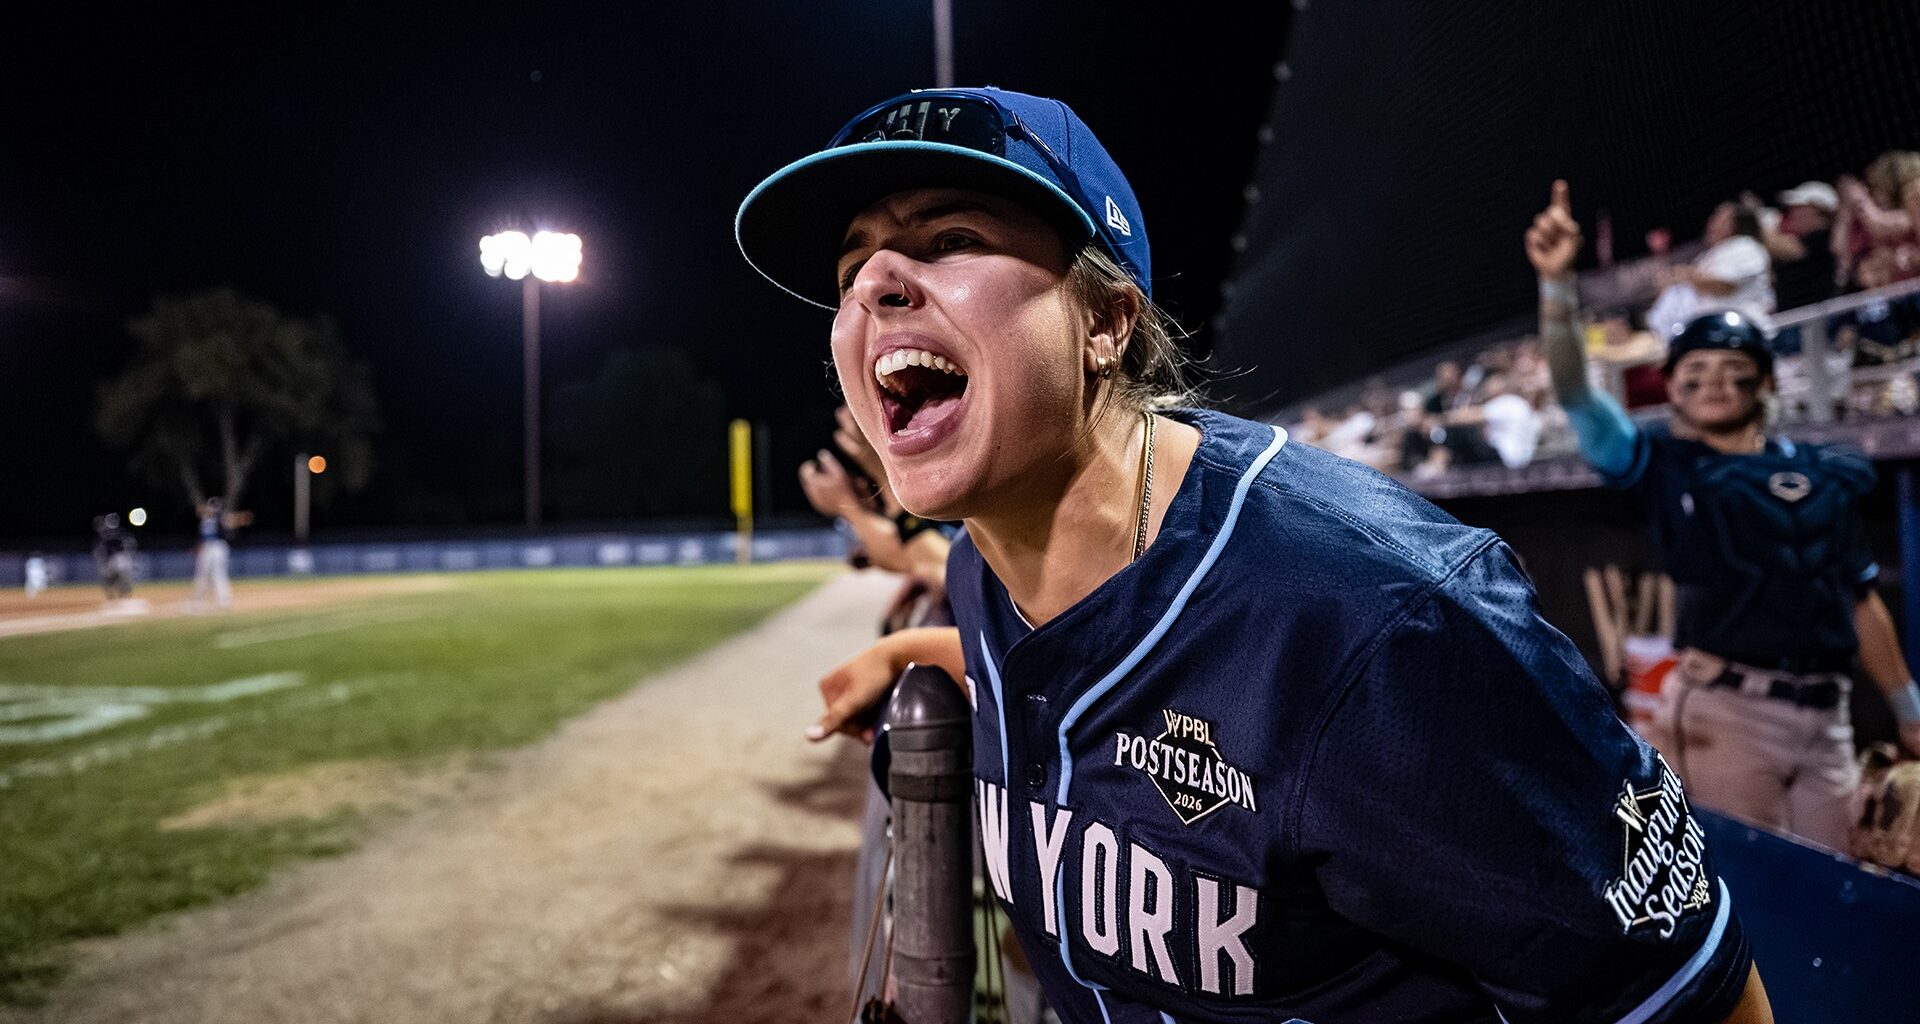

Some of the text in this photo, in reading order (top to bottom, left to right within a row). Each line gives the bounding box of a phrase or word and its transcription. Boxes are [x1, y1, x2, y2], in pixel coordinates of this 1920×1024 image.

[1162, 709, 1216, 747] WPBL
[1114, 732, 1256, 812] POSTSEASON
[1173, 792, 1202, 811] 2026
[1604, 752, 1682, 935] Inaugural
[1645, 814, 1706, 939] Season
[1029, 800, 1259, 996] YORK
[1690, 876, 1709, 909] 2026
